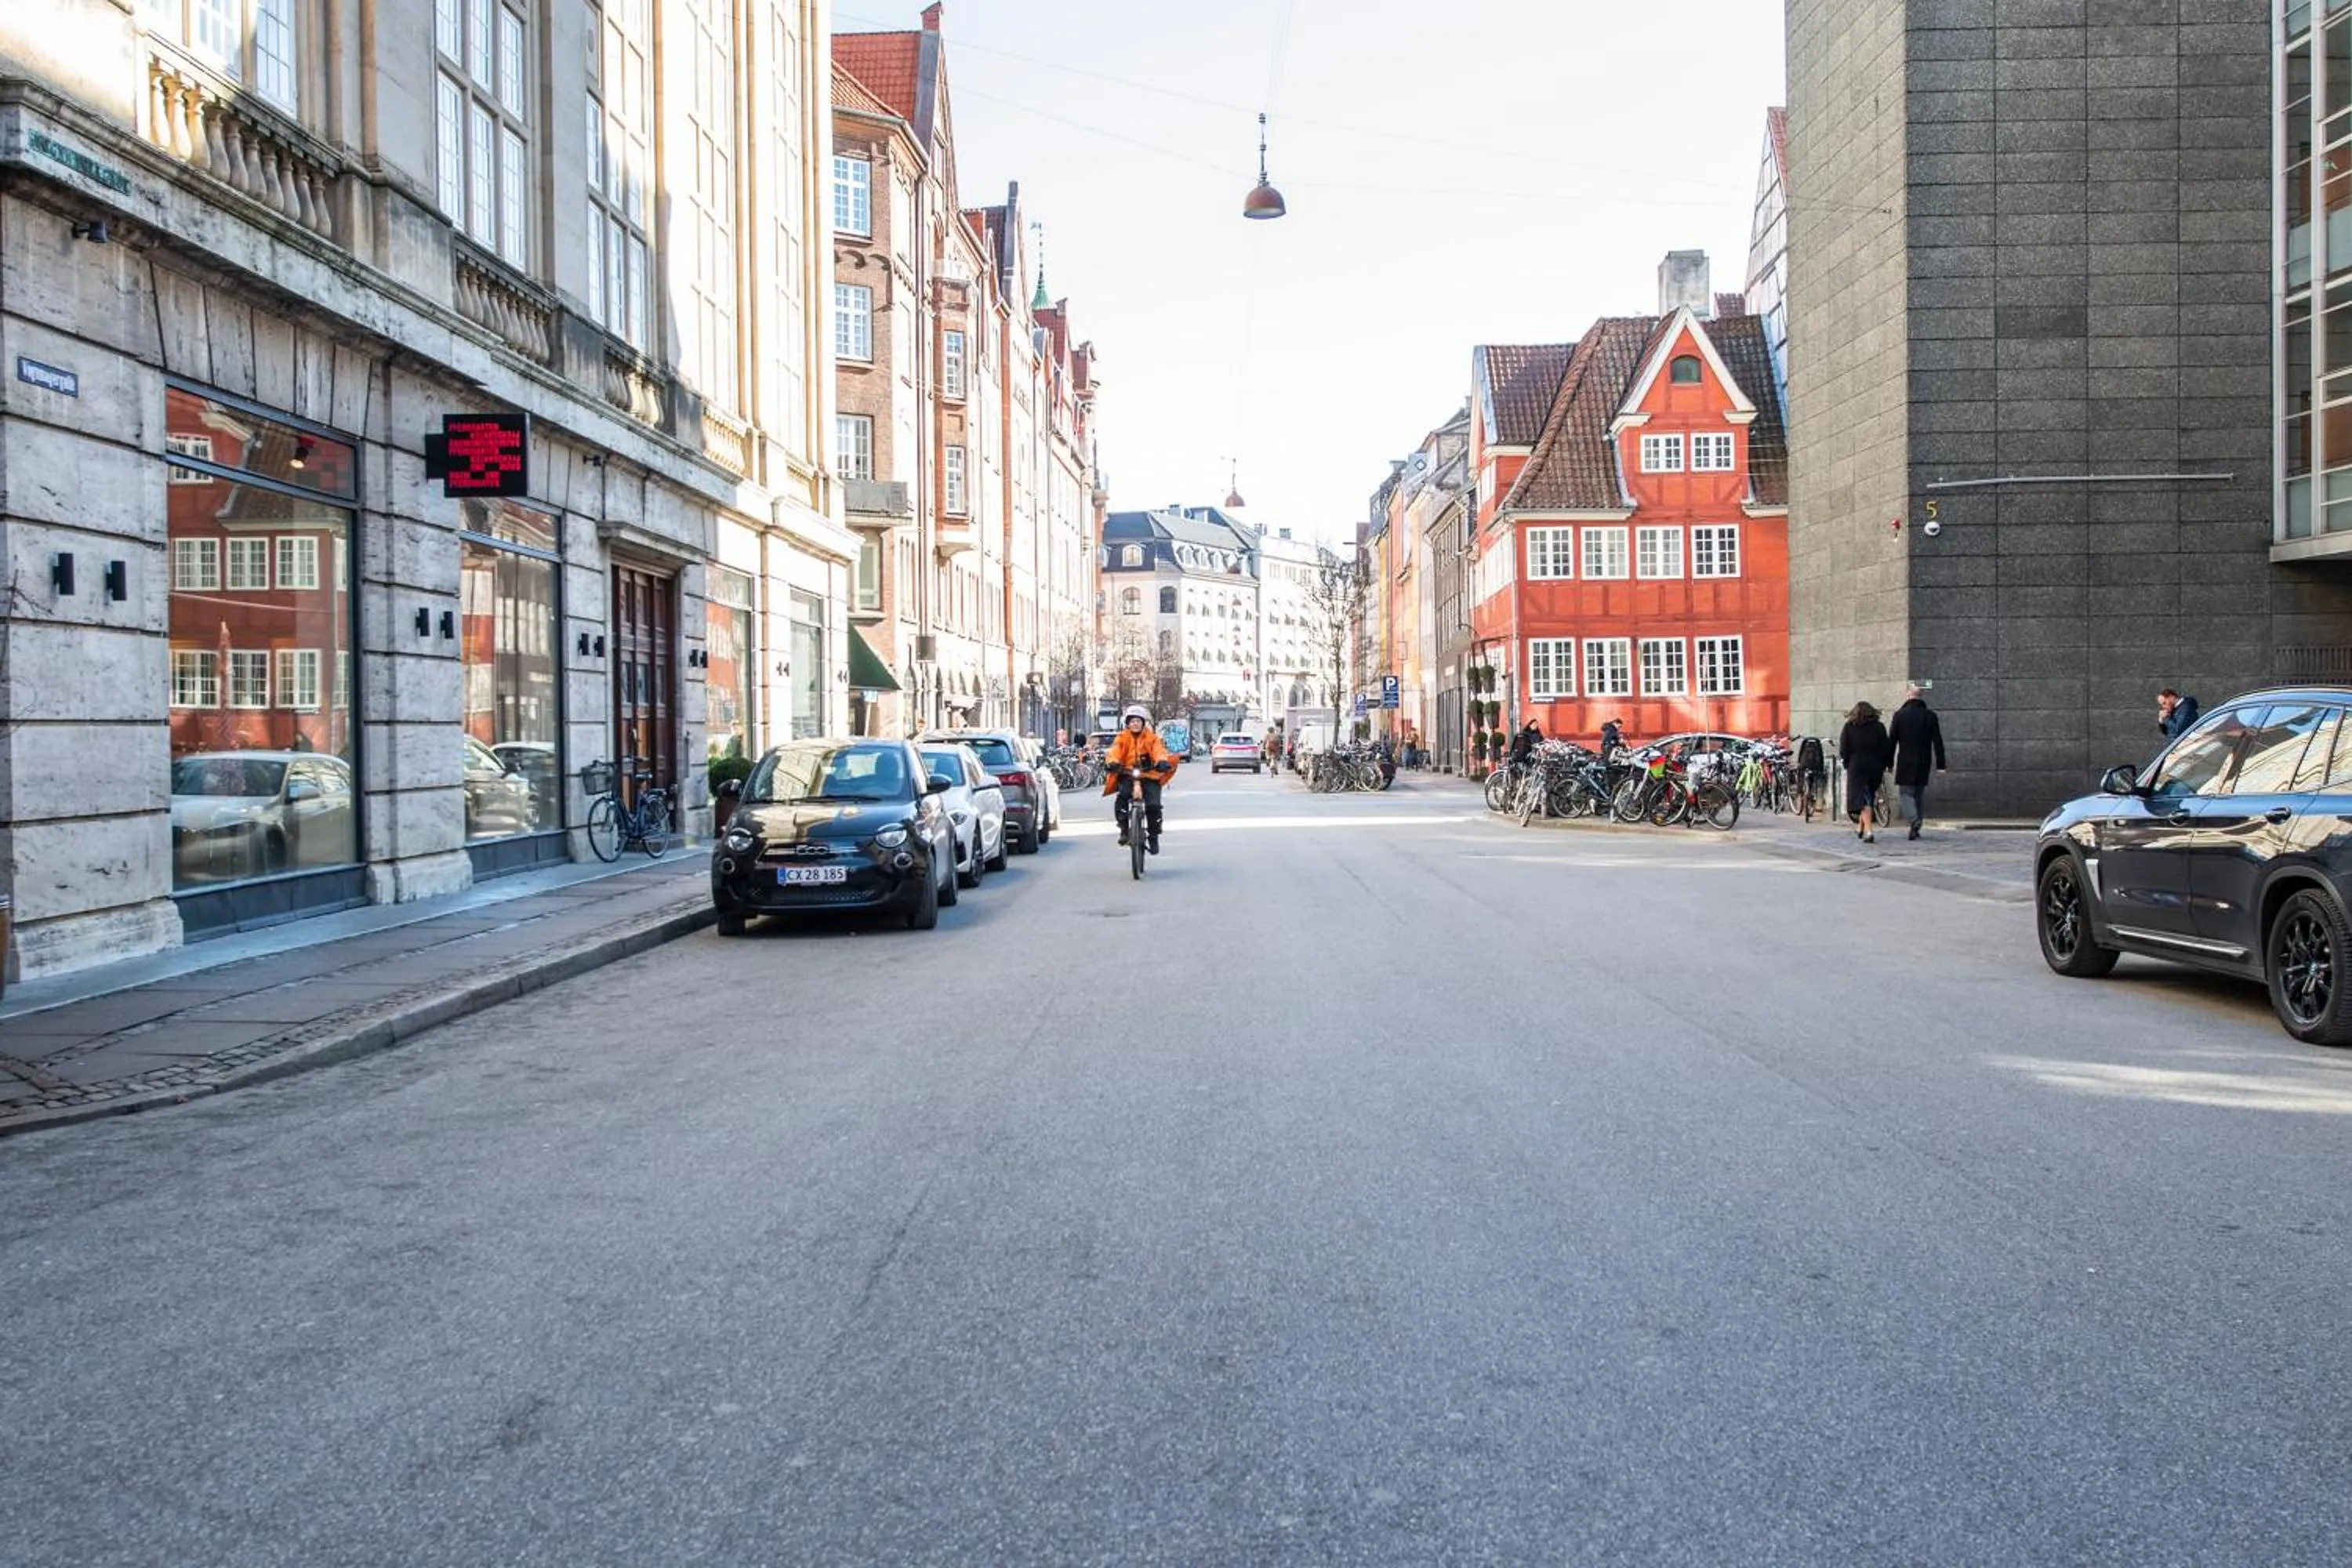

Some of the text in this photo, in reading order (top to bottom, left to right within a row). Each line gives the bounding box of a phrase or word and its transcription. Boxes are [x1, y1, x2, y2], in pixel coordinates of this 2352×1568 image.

[1926, 501, 1937, 518] 5
[1385, 677, 1396, 691] P
[1357, 694, 1365, 704] P
[786, 869, 803, 880] CX
[804, 869, 820, 880] 28
[824, 868, 844, 880] 185
